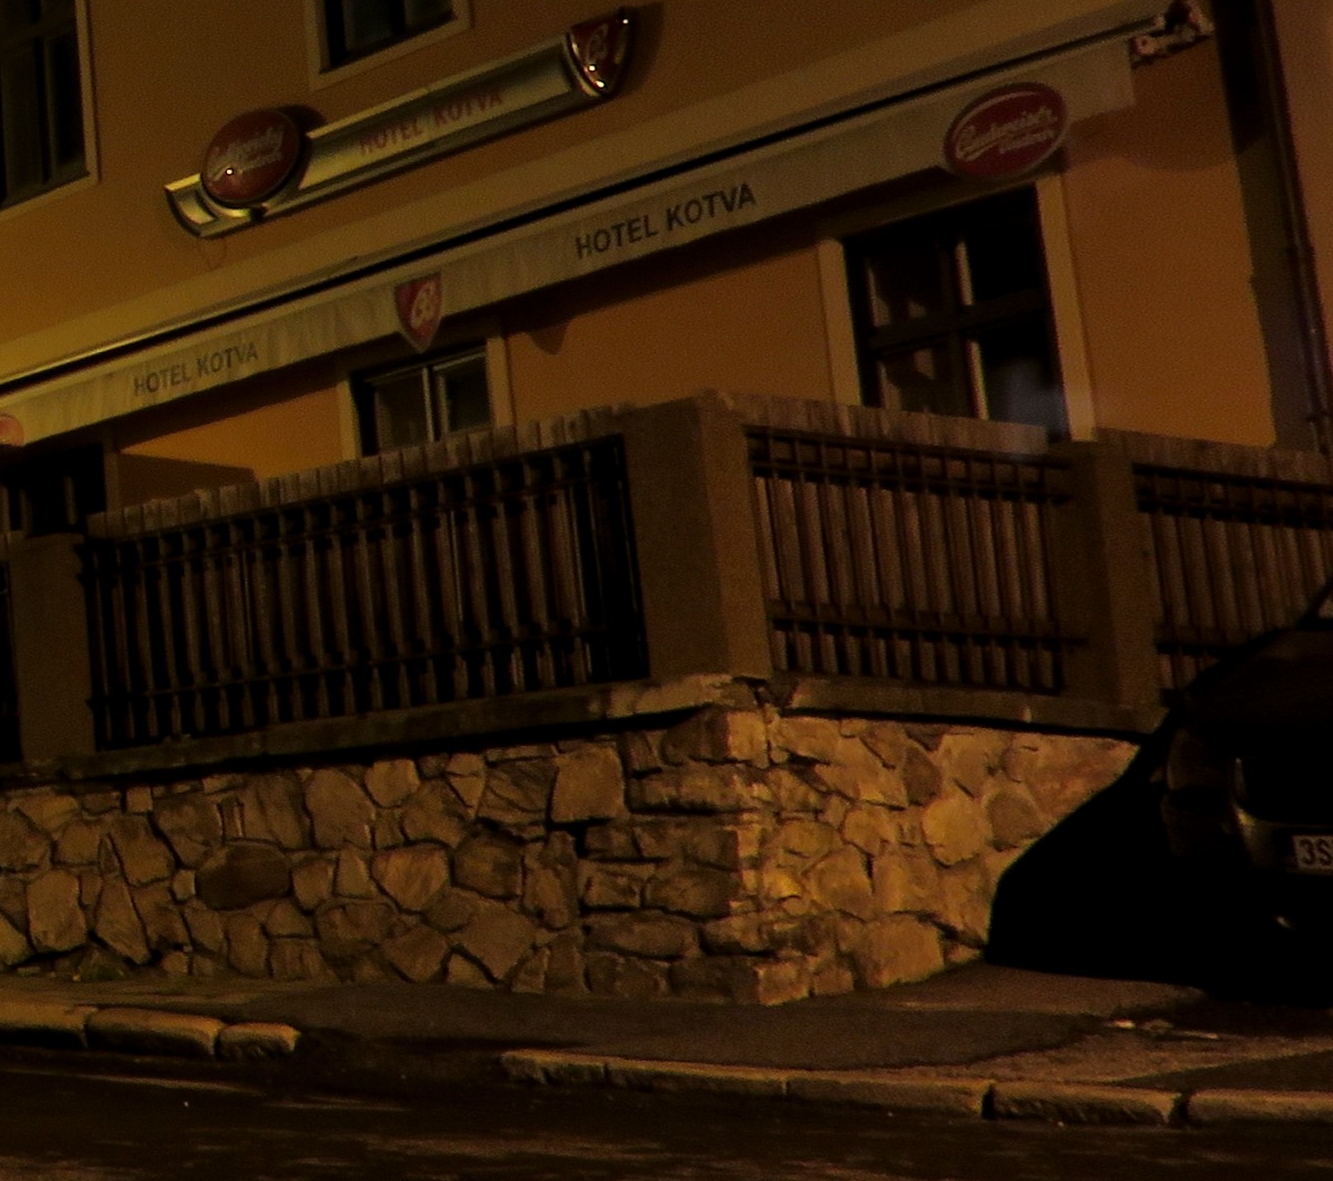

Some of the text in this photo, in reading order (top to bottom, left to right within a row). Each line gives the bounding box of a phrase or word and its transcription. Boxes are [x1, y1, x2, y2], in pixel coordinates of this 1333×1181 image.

[359, 84, 503, 156] HOTEL KOTVA
[575, 182, 756, 260] HOTEL KOTVA
[133, 341, 259, 397] HOTEL KOTVA
[1299, 838, 1333, 866] 3S
